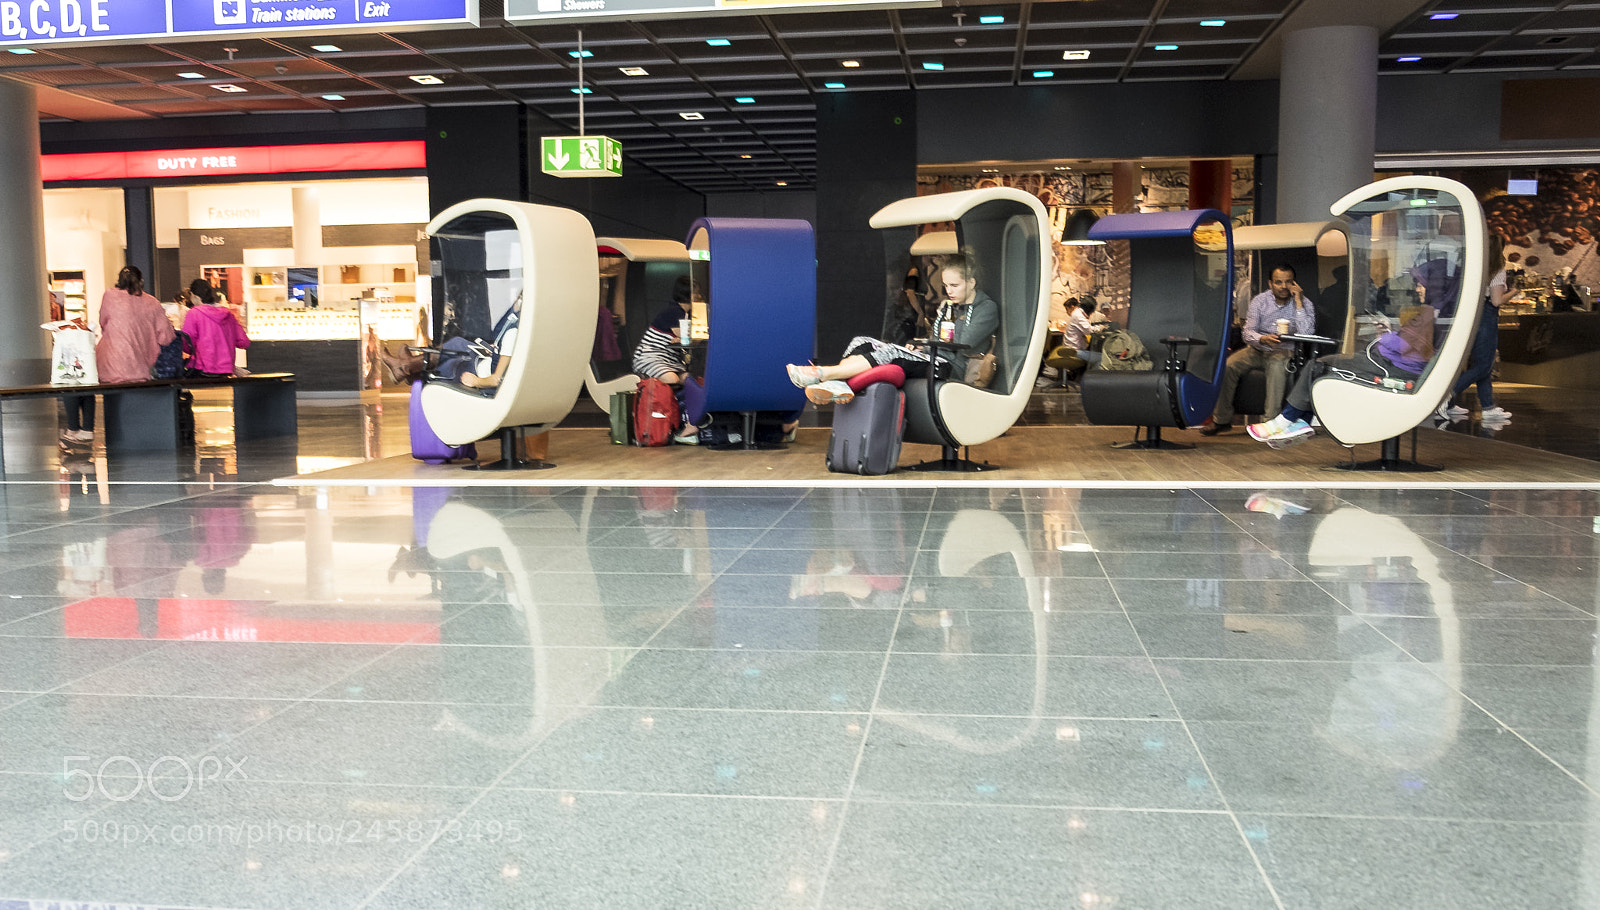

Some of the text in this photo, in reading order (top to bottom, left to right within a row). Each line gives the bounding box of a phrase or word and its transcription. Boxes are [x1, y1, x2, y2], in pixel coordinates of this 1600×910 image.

[252, 4, 337, 23] Train stations
[363, 1, 391, 18] Exit
[563, 0, 606, 11] Showers
[157, 155, 237, 170] DUTY FREE
